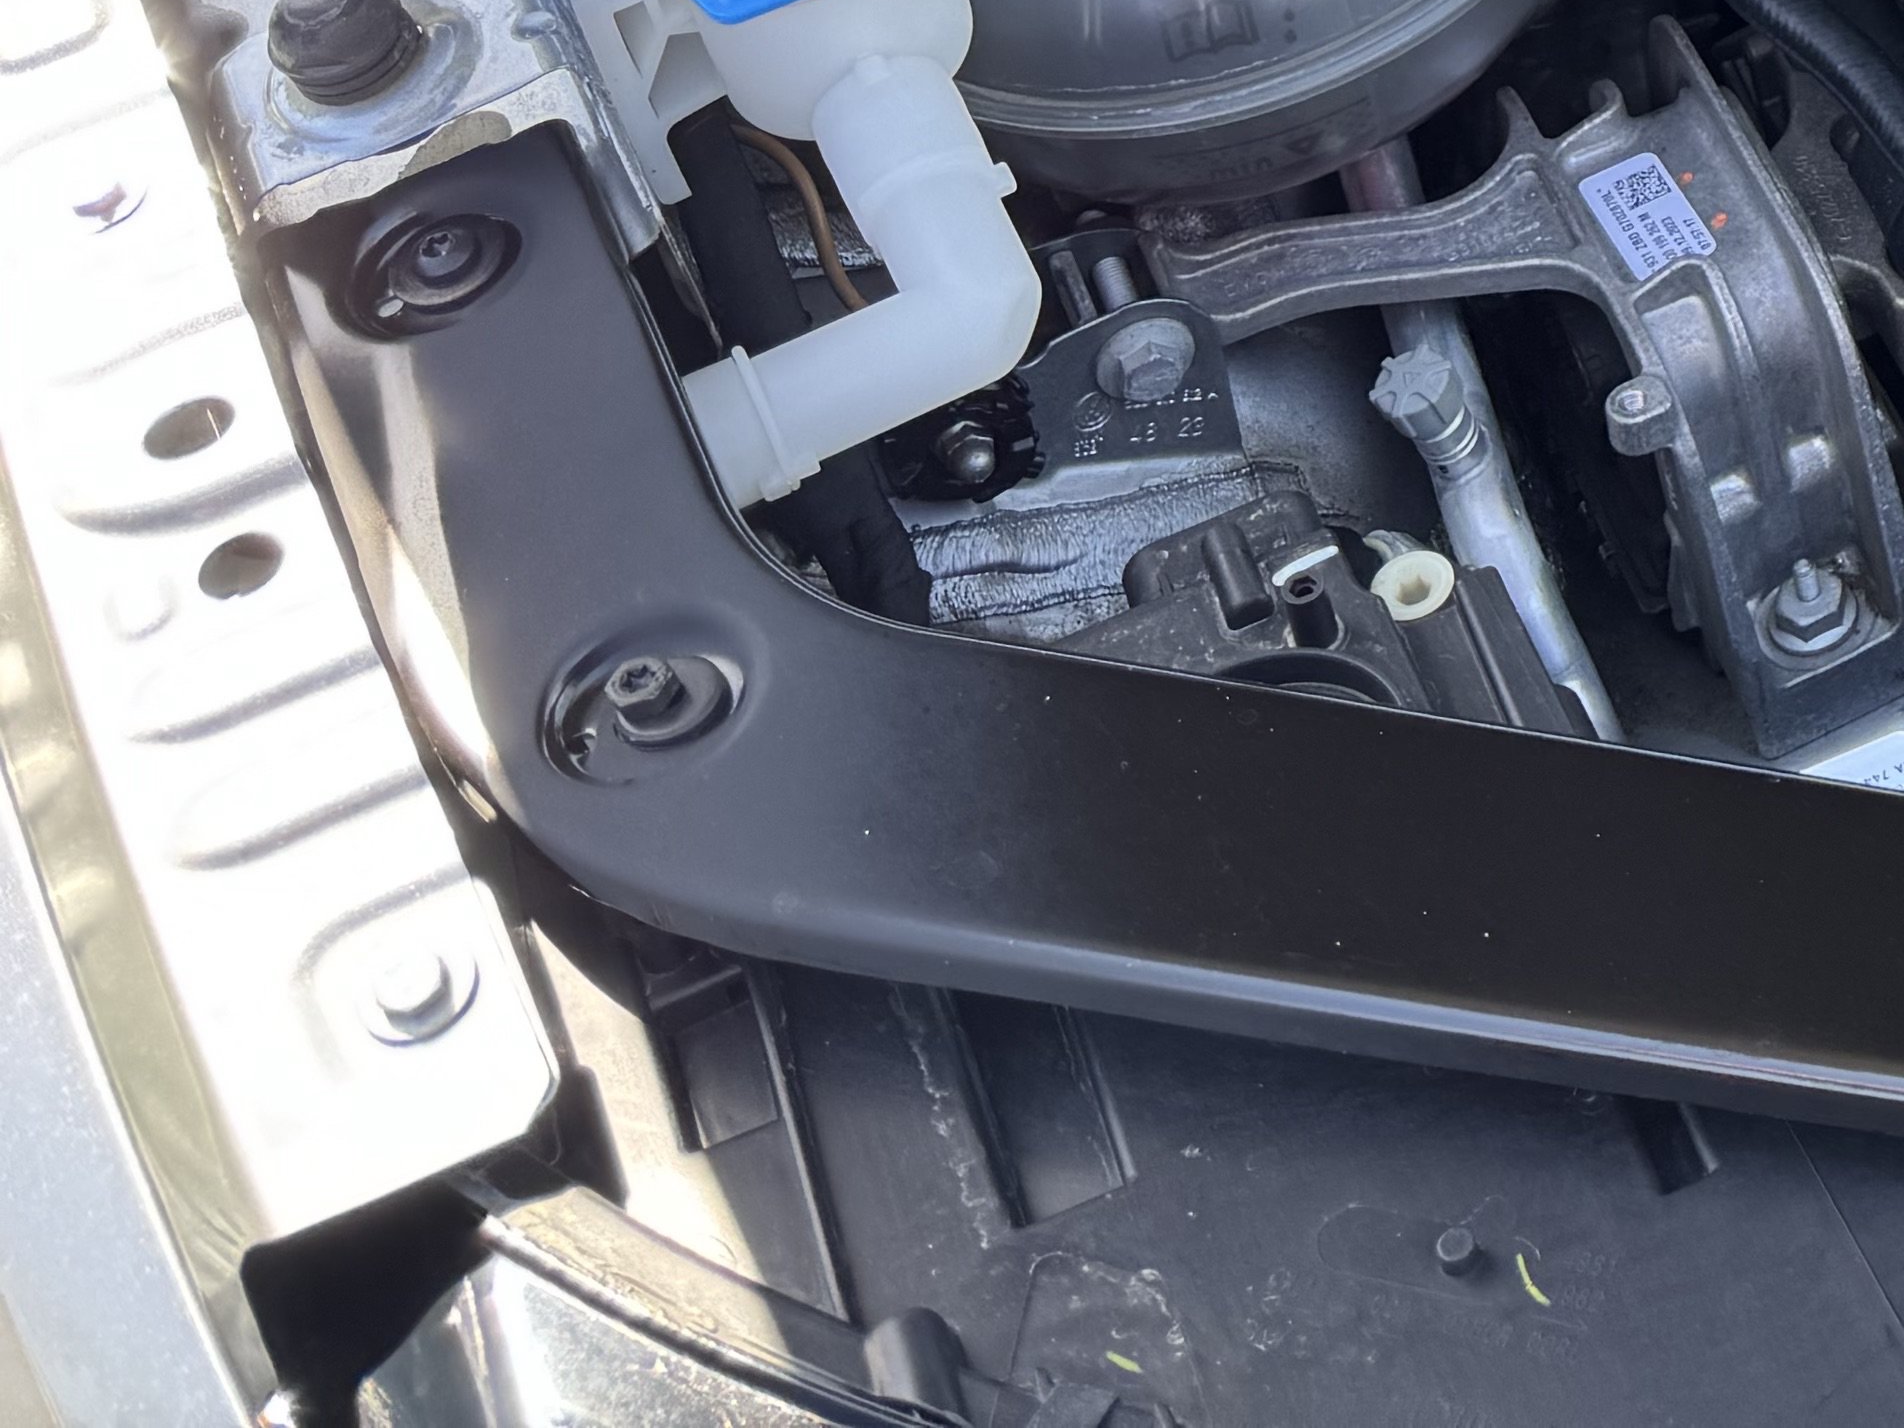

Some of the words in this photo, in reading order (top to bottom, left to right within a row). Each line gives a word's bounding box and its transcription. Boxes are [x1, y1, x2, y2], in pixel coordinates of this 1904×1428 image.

[1638, 210, 1651, 222] M
[1644, 220, 1660, 237] 262
[1627, 230, 1647, 252] ZBD
